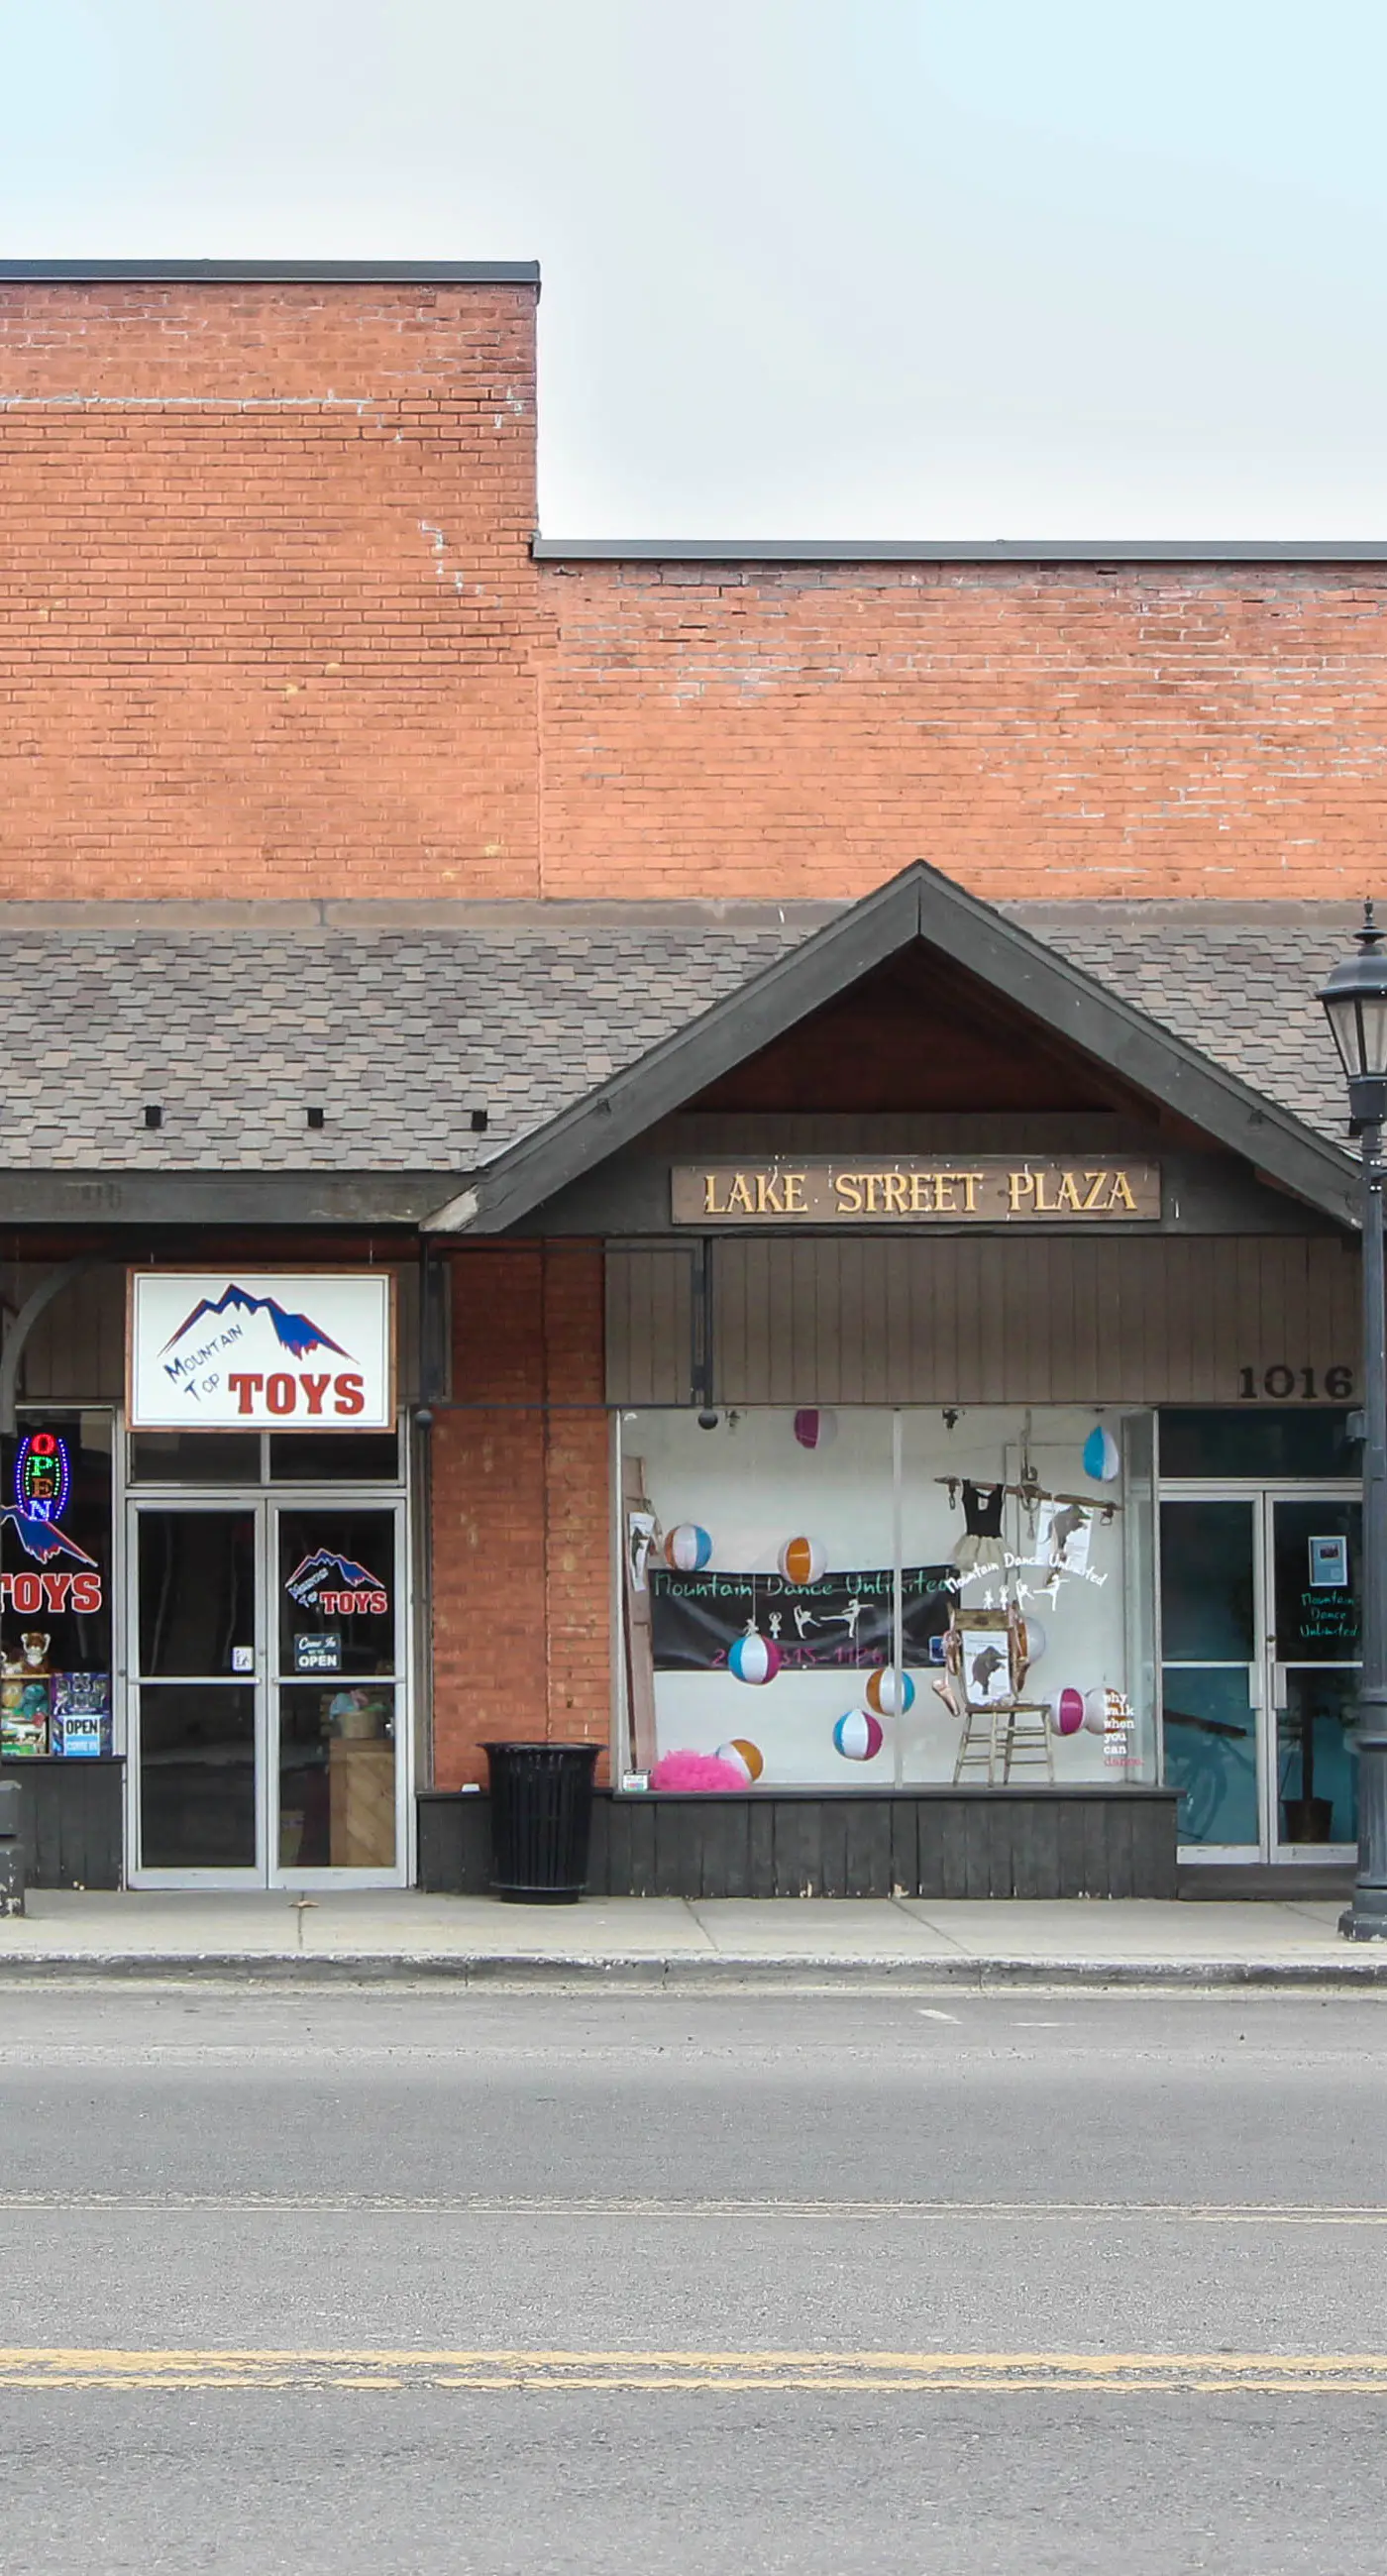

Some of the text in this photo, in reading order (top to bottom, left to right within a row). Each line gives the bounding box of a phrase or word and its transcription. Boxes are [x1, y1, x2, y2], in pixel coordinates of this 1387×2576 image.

[704, 1171, 1138, 1215] LAKE STREET PLAZA
[163, 1324, 244, 1384] MOUNTAIN
[183, 1372, 221, 1402] TOP
[228, 1372, 366, 1416] TOYS
[1239, 1365, 1353, 1400] 1016
[30, 1433, 56, 1521] OPEN
[1048, 1552, 1109, 1587] Unlted
[655, 1572, 753, 1597] Mountain
[767, 1577, 833, 1597] Dance
[319, 1590, 387, 1614] TOYS
[298, 1654, 338, 1667] OPEN
[64, 1718, 99, 1735] OPEN
[1104, 1715, 1134, 1729] when
[1103, 1745, 1127, 1756] can
[1104, 1732, 1127, 1744] you
